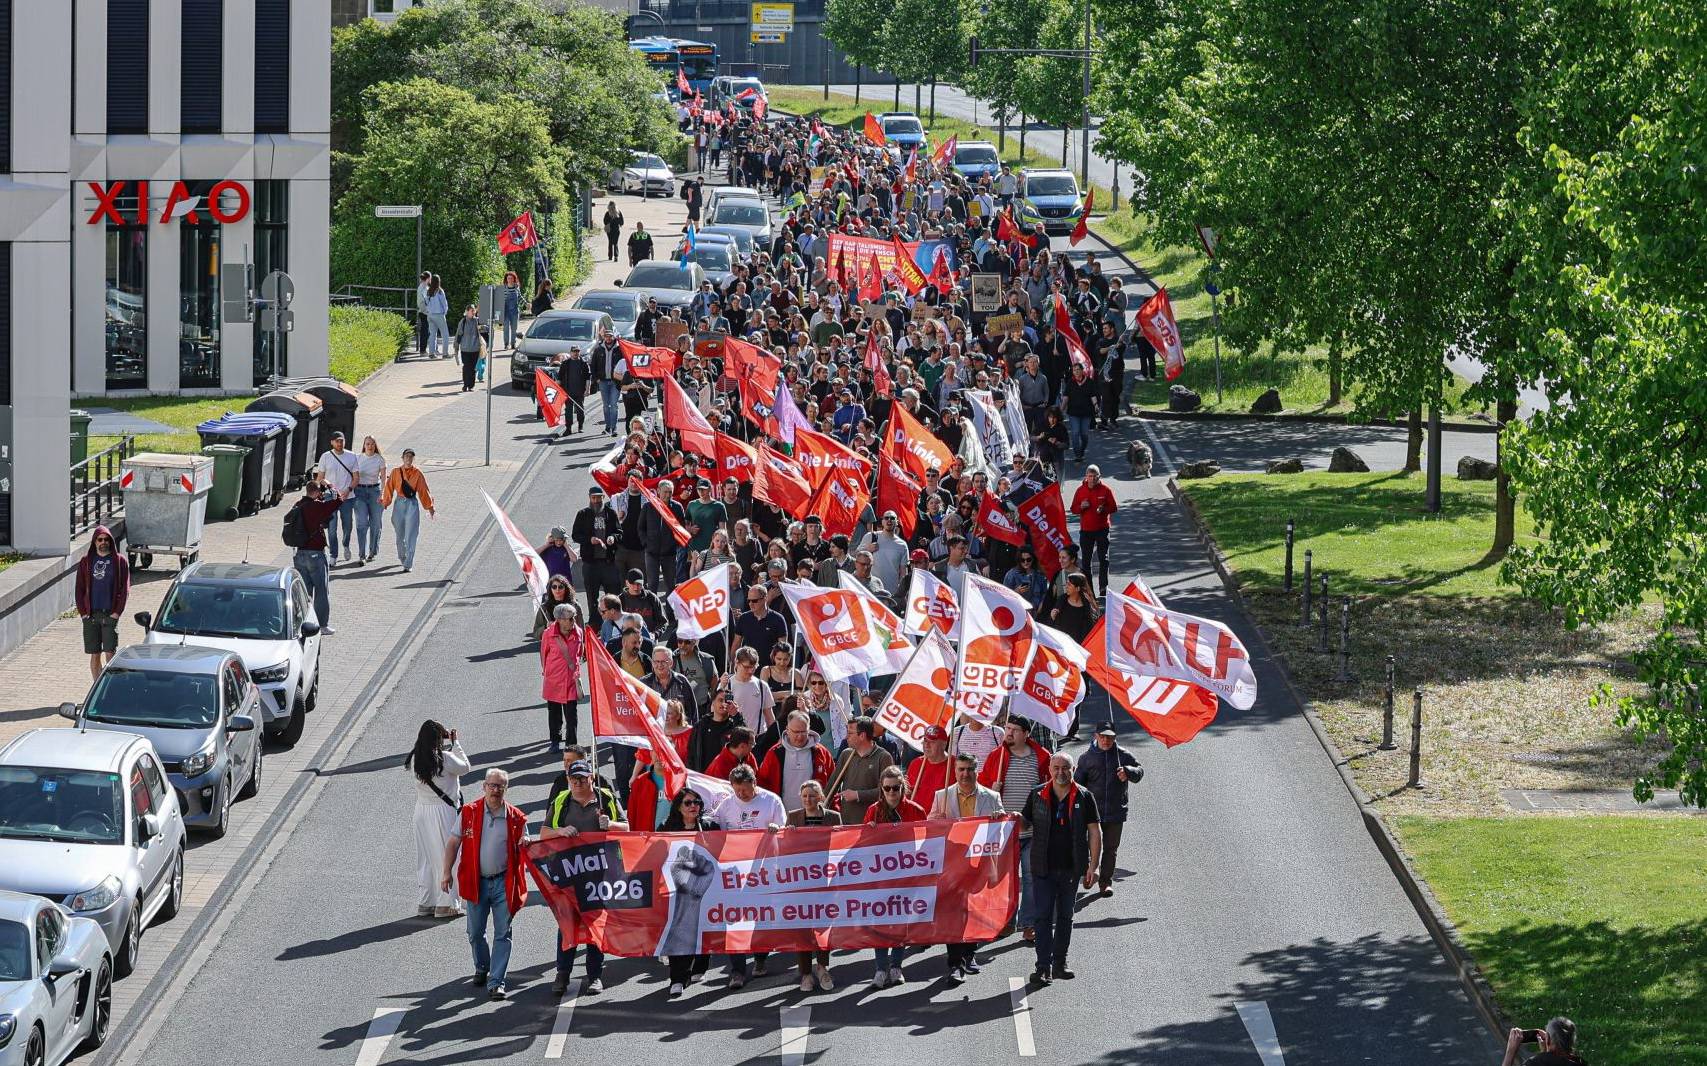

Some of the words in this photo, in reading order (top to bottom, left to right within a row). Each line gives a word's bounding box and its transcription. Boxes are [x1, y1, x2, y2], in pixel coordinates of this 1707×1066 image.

[86, 180, 251, 225] XIAO
[726, 454, 749, 470] Die
[799, 452, 821, 467] Die
[823, 453, 862, 469] Linke
[906, 438, 941, 468] Linke
[1026, 506, 1048, 532] Die
[1046, 527, 1064, 552] Lin
[822, 631, 859, 649] IGBCE
[973, 842, 1000, 854] DGB
[562, 851, 609, 878] Mai
[721, 871, 770, 891] Erst
[774, 859, 863, 884] unsere
[868, 850, 936, 874] Jobs,
[585, 879, 644, 902] 2026
[707, 901, 776, 923] dann
[782, 904, 840, 921] eure
[845, 896, 928, 919] Profite
